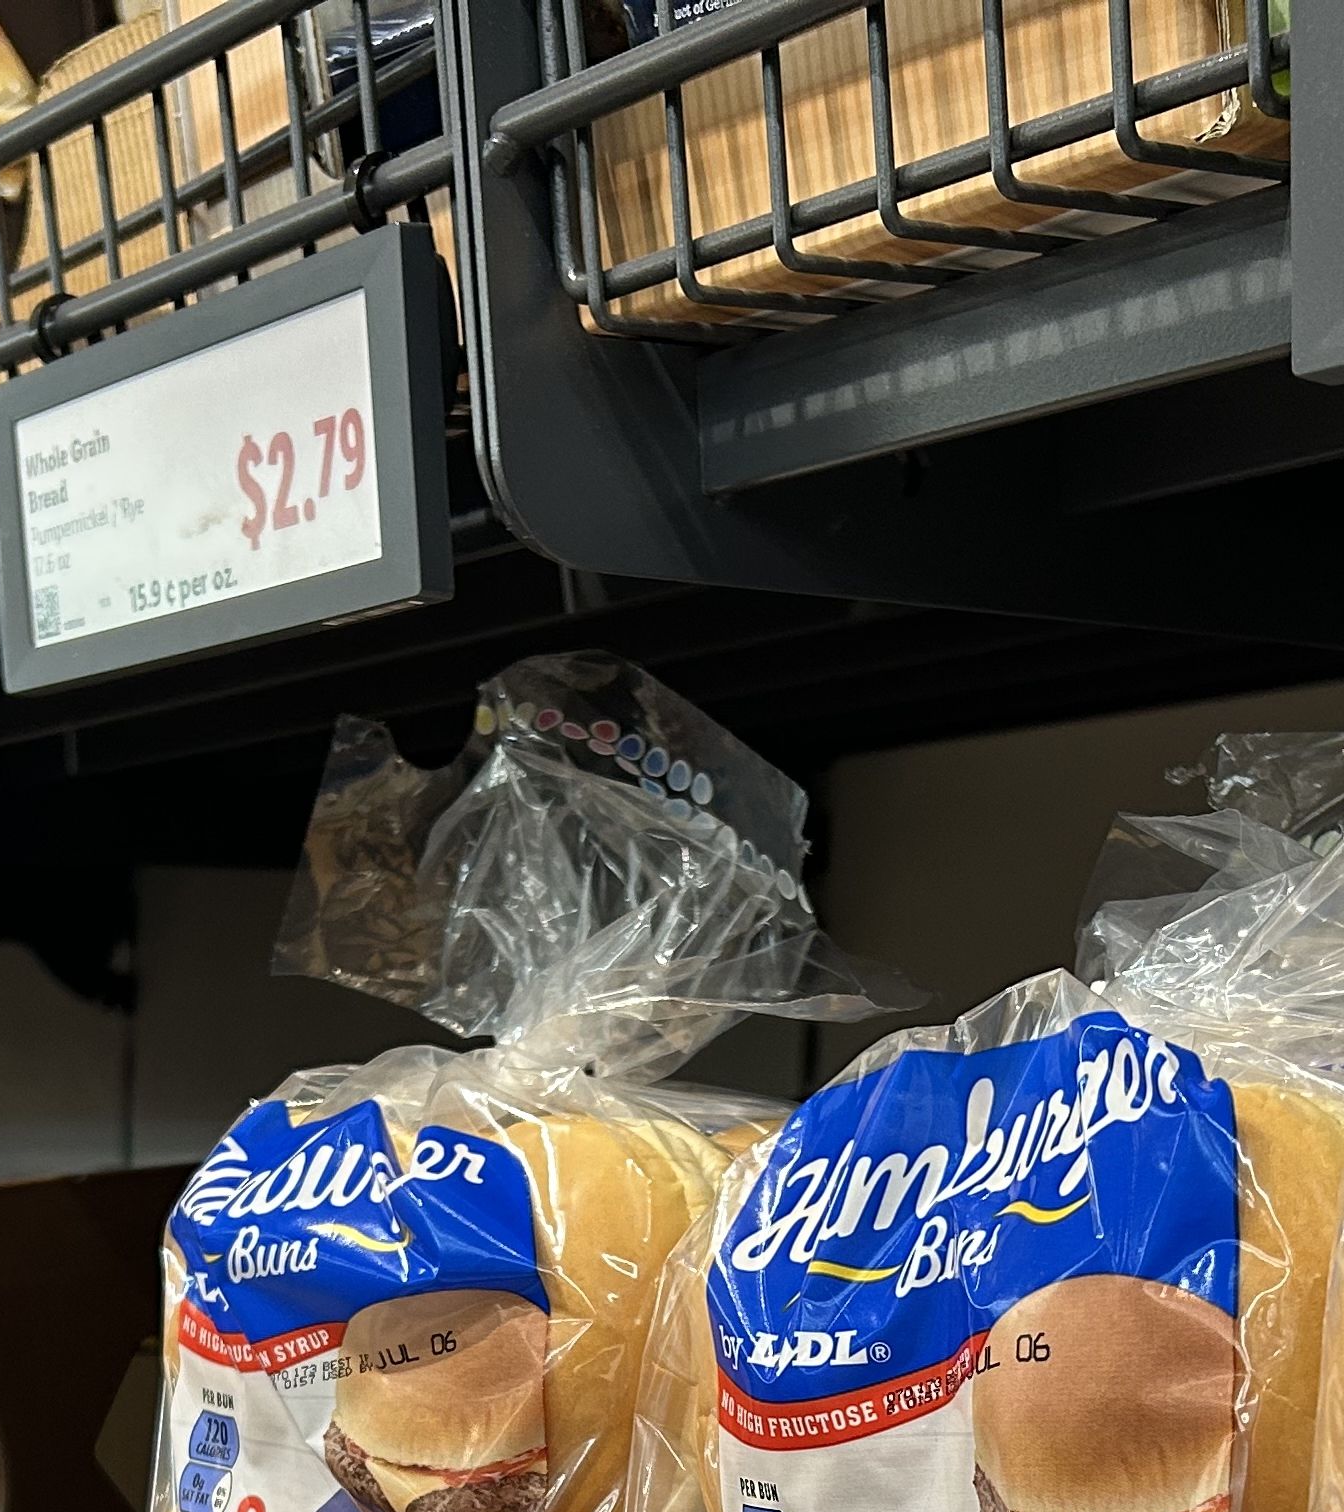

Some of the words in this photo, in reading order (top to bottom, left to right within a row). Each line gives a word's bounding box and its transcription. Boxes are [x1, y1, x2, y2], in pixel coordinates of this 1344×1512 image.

[26, 446, 69, 479] Whole
[70, 429, 111, 464] Grain
[28, 479, 69, 514] Bread
[236, 407, 366, 551] $2.79
[129, 580, 161, 612] 15.9
[179, 574, 207, 608] per
[213, 567, 238, 590] oz.
[227, 1226, 319, 1284] Buns
[182, 1313, 198, 1338] NO
[272, 1329, 331, 1365] SYRUP
[322, 1356, 352, 1373] BEST
[375, 1345, 420, 1371] JUL
[431, 1331, 457, 1357] 06
[719, 1325, 743, 1370] by
[1016, 1332, 1051, 1363] 06
[284, 1374, 317, 1390] 0157
[322, 1366, 352, 1381] USED
[202, 1388, 215, 1406] PER
[217, 1391, 234, 1410] BUN
[720, 1389, 736, 1417] NO
[736, 1406, 764, 1436] HIGH
[768, 1400, 878, 1438] FRUCTOSE
[206, 1418, 228, 1445] 120
[739, 1477, 755, 1498] PER
[758, 1481, 779, 1502] BUN
